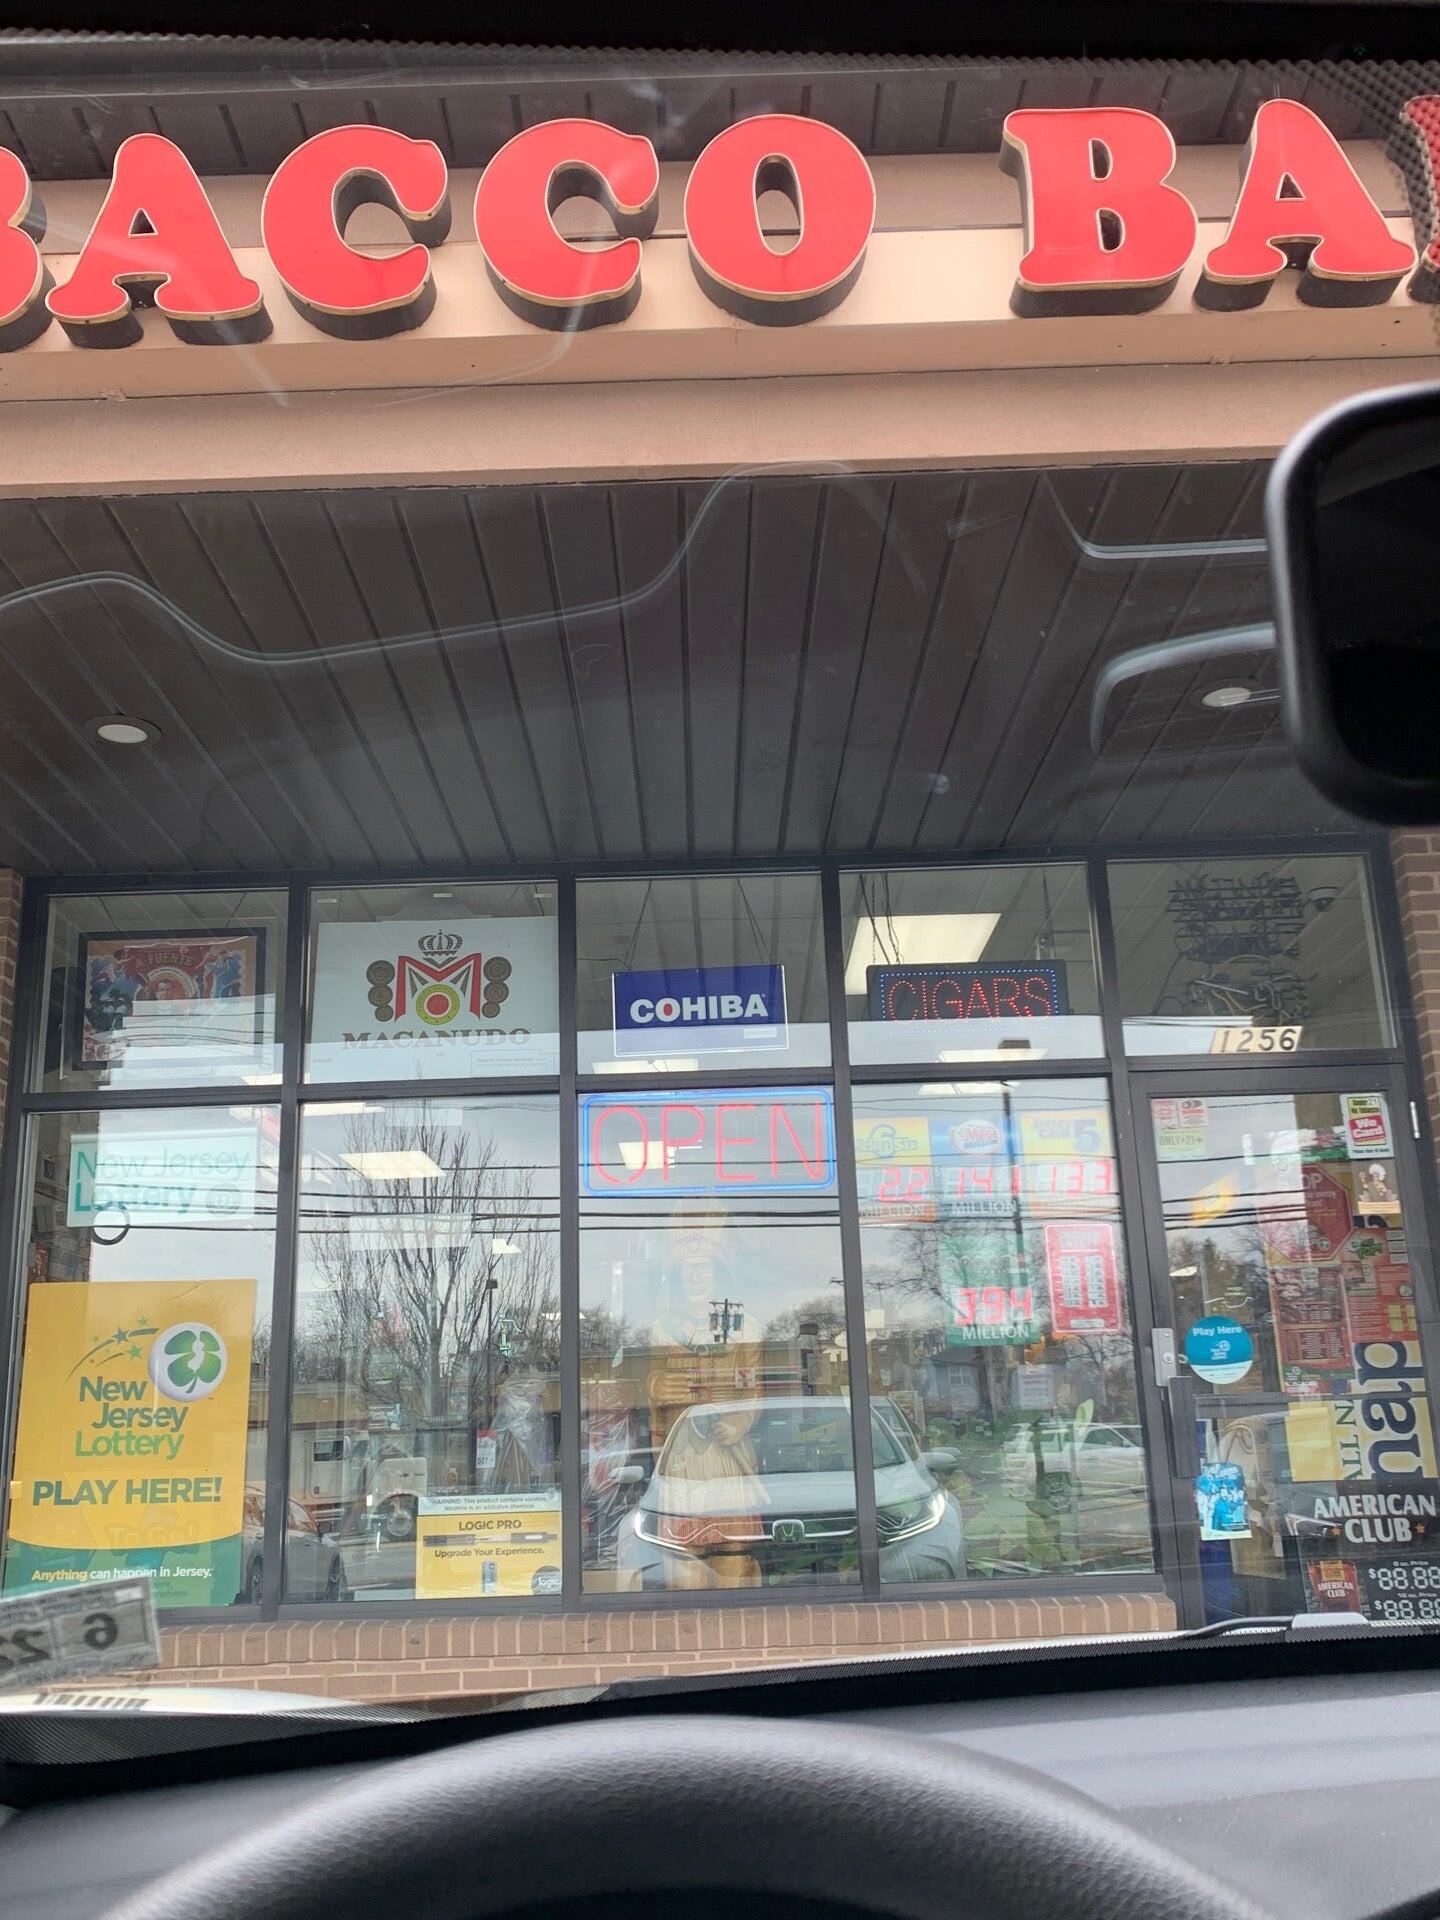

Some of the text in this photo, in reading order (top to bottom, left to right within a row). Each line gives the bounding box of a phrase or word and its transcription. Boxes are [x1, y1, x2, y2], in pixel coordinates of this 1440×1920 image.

[1000, 97, 1440, 302] BA
[630, 993, 768, 1024] COHIBA
[886, 976, 1052, 1022] CIGARS
[341, 1028, 531, 1050] MACANUDO
[1220, 1028, 1297, 1053] 1256
[1352, 1126, 1383, 1138] Card
[1356, 1119, 1377, 1128] We
[593, 1101, 823, 1184] OPEN
[76, 1151, 147, 1180] New
[879, 1167, 929, 1201] 22
[75, 1182, 197, 1214] Lottery
[952, 1200, 1018, 1216] MILLION
[954, 1286, 1033, 1325] 394
[962, 1326, 1030, 1340] MILLION
[1192, 1326, 1242, 1336] Play Here
[79, 1376, 148, 1402] New
[91, 1405, 188, 1432] Jersey
[75, 1430, 184, 1460] Lottery
[33, 1476, 222, 1506] PLAY HERE!
[1314, 1494, 1435, 1519] AMERICAN
[458, 1519, 522, 1531] LOGIC PRO
[1344, 1518, 1412, 1543] CLUB
[434, 1547, 545, 1559] Upgrade Your Experience.
[32, 1570, 88, 1582] Anything
[90, 1570, 110, 1578] can
[160, 1567, 171, 1576] in
[172, 1566, 212, 1579] Jersey.
[1318, 1582, 1354, 1591] AMERICAN
[1327, 1589, 1346, 1598] CLUB
